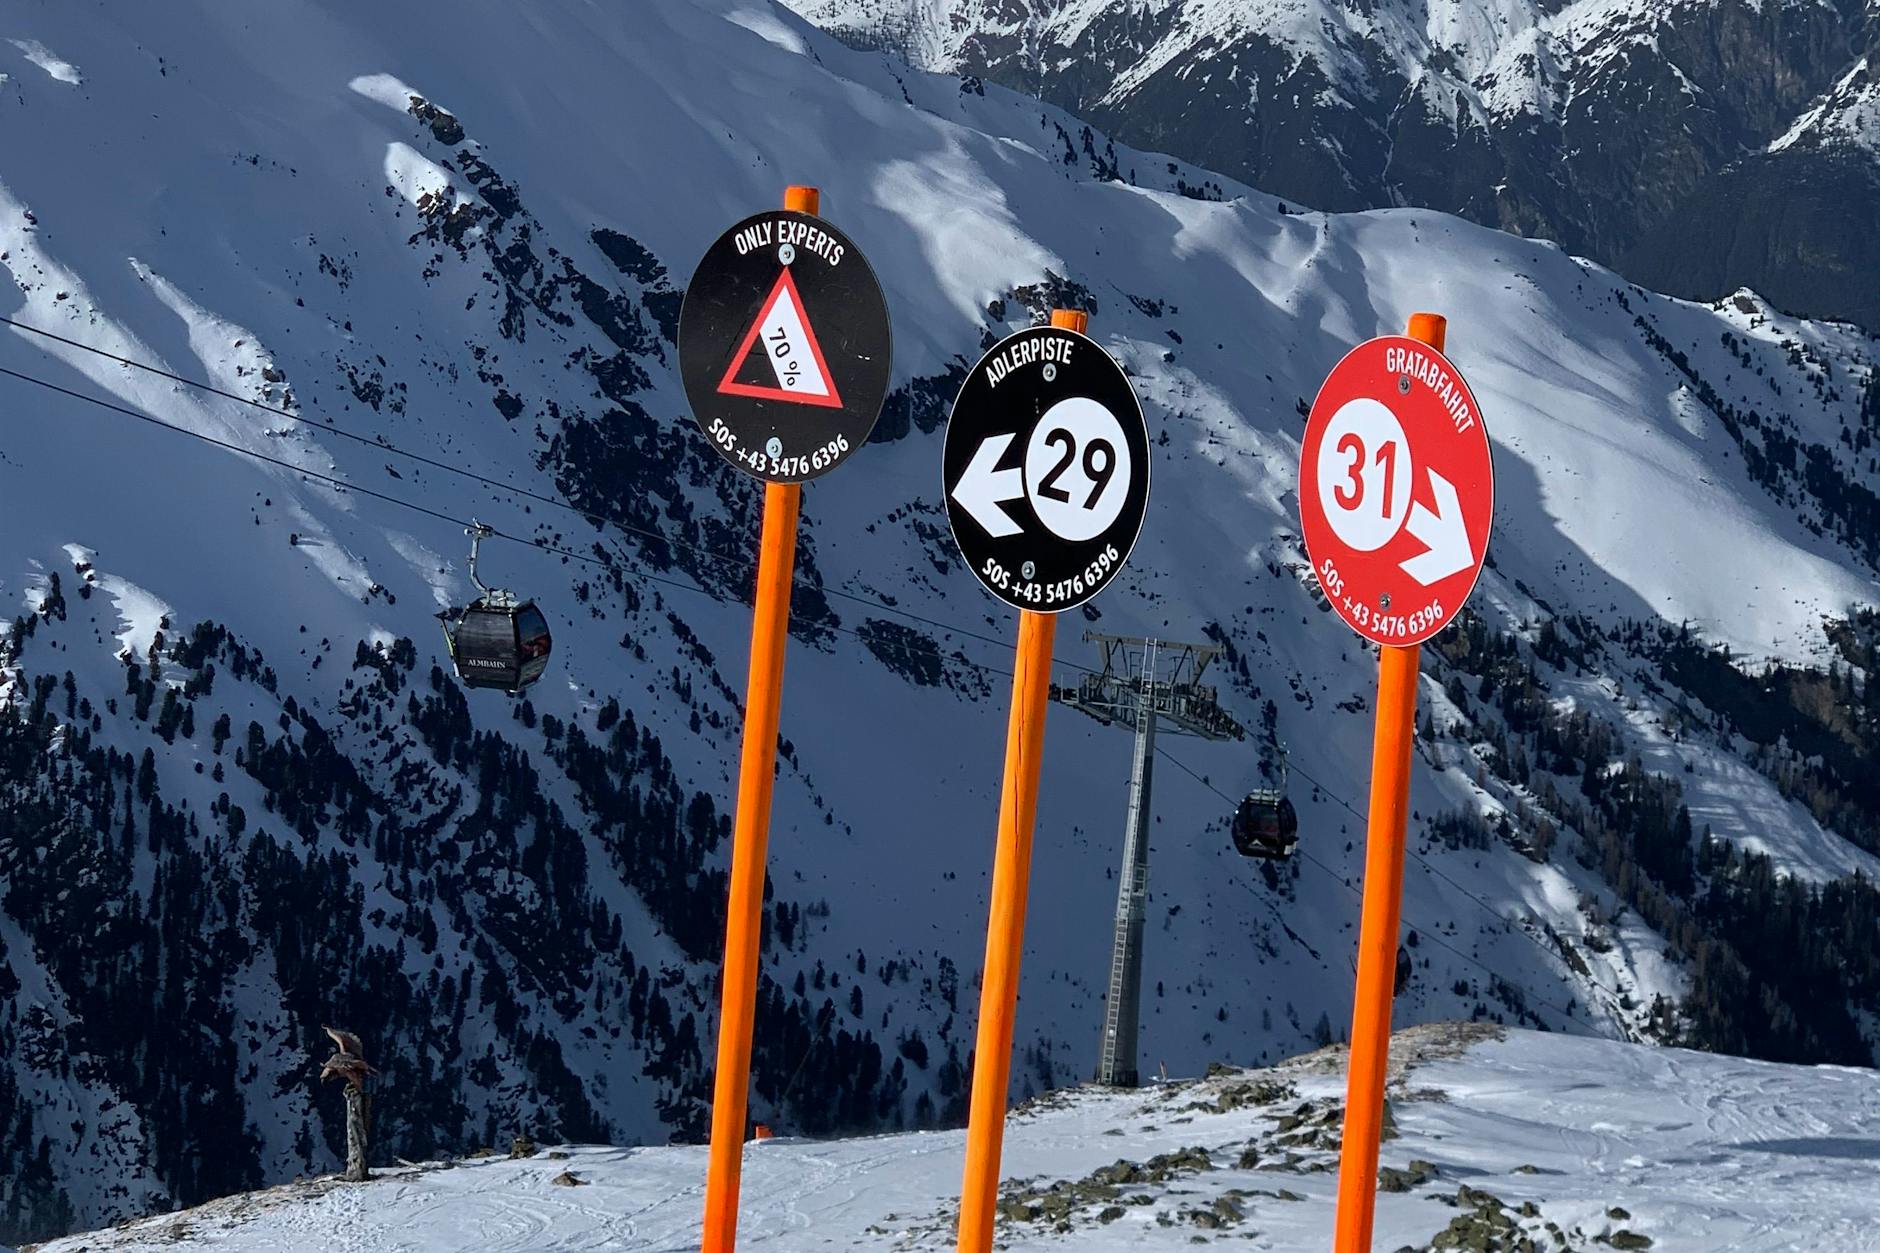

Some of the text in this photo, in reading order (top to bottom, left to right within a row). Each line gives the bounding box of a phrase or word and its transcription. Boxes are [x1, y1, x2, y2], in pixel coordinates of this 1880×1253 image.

[735, 220, 844, 266] ONLY EXPERTS
[769, 327, 791, 358] 70
[985, 337, 1075, 388] ADLERPISTE
[1386, 347, 1475, 434] GRATABFAHRT
[708, 418, 849, 476] SOS +43 5476 6396
[1037, 428, 1116, 511] 29
[1334, 432, 1396, 519] 31
[982, 543, 1119, 603] SOS +43 5476 6396
[1320, 558, 1444, 637] SOS +43 5476 6396
[467, 660, 506, 669] ALMBAHN
